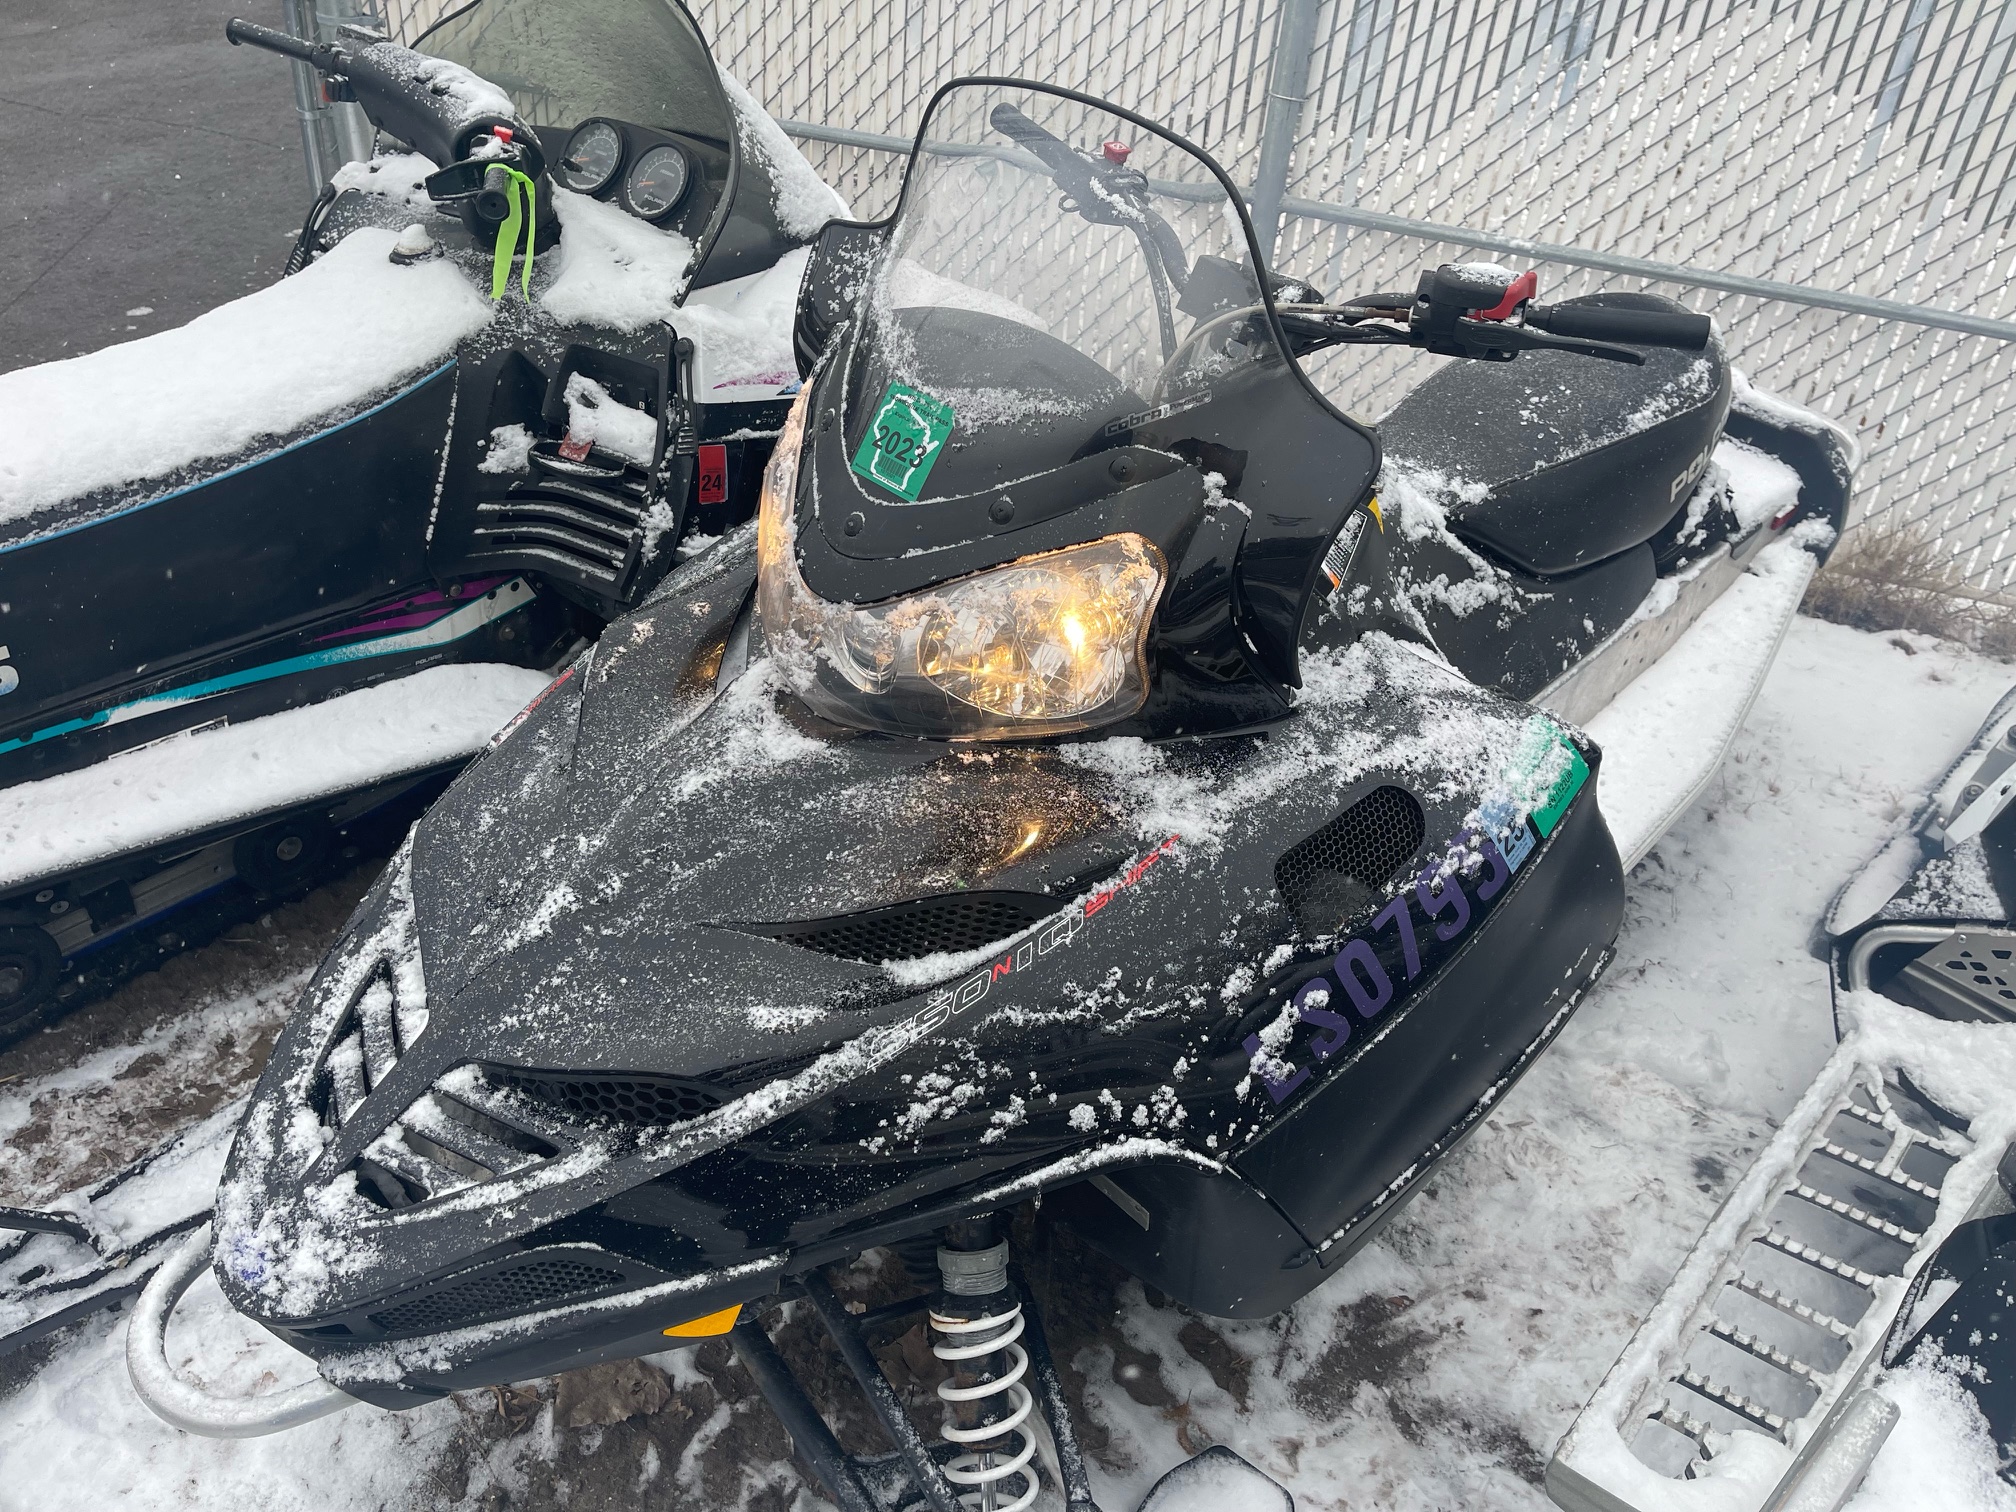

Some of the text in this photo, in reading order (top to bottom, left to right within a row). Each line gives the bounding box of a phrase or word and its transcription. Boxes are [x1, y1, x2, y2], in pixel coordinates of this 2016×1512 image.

[644, 193, 667, 206] POLARIS
[1107, 408, 1162, 435] cobra
[872, 425, 927, 468] 2023
[701, 473, 723, 492] 24
[415, 652, 443, 666] POLARIS
